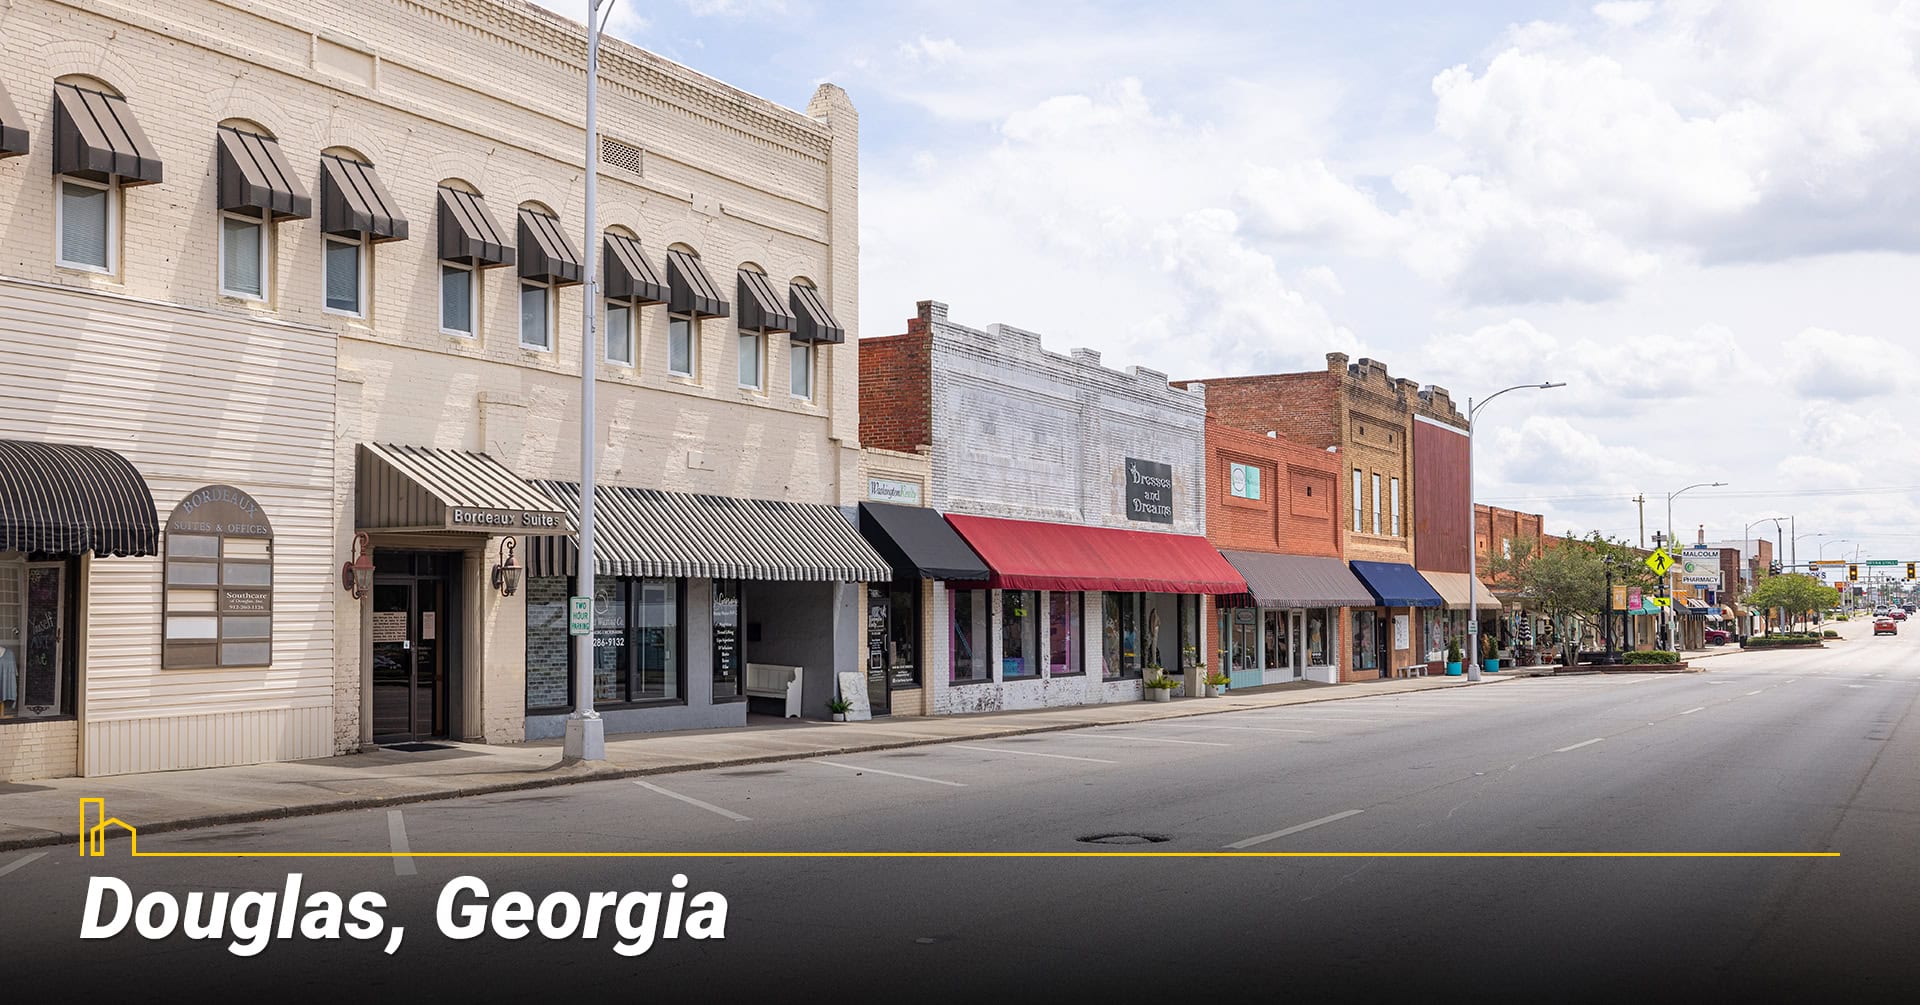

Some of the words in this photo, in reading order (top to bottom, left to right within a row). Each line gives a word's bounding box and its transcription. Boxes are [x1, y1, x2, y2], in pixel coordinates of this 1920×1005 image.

[1133, 470, 1171, 489] Dresses
[183, 488, 257, 519] BORDEAUX
[1144, 490, 1160, 501] and
[1133, 498, 1171, 516] Dreams
[454, 508, 516, 526] Bordeaux
[522, 511, 560, 527] Suites
[174, 521, 211, 532] SUITES
[215, 524, 223, 532] &
[227, 523, 267, 535] OFFICES
[573, 611, 588, 620] HOUR
[572, 622, 590, 630] PARKING
